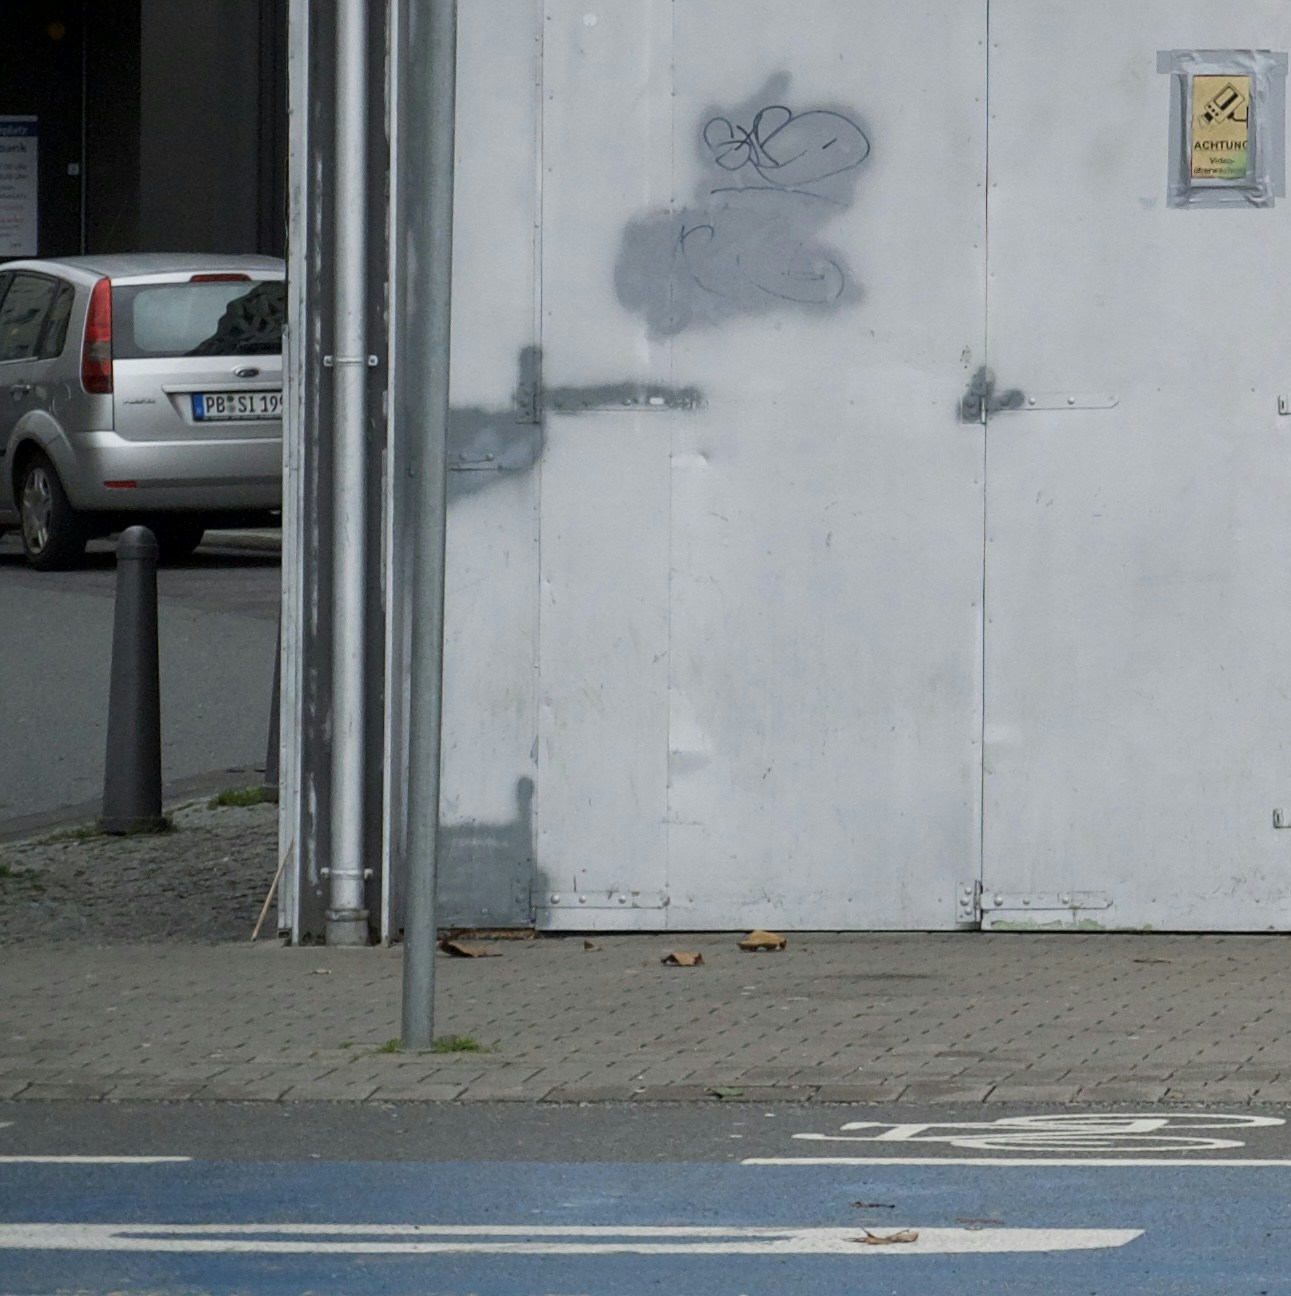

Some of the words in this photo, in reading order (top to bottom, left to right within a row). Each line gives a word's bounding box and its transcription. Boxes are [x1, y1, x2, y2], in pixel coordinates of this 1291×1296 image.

[206, 396, 226, 413] PB
[238, 395, 256, 413] SI
[260, 395, 283, 413] 19
